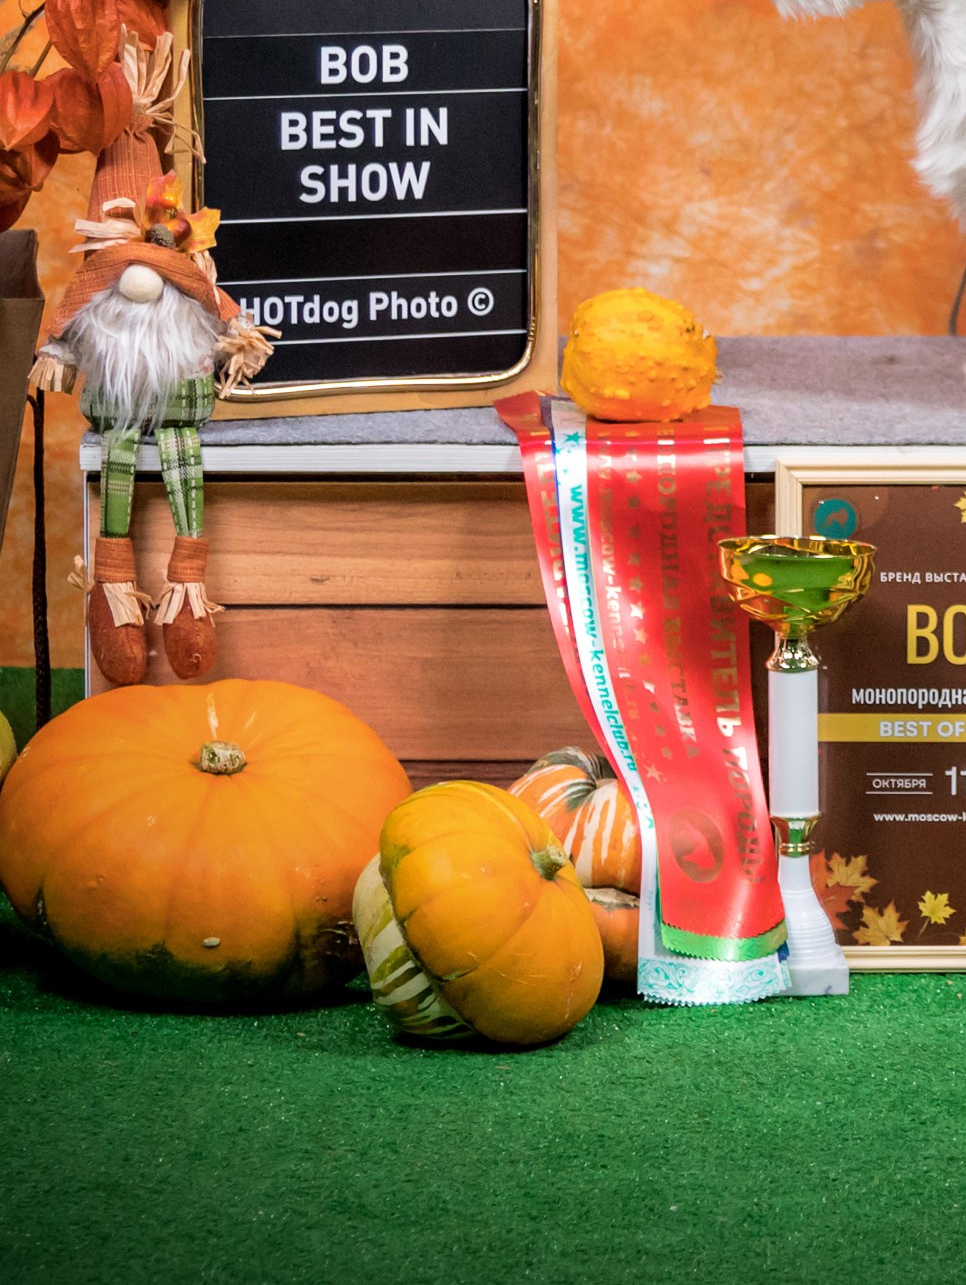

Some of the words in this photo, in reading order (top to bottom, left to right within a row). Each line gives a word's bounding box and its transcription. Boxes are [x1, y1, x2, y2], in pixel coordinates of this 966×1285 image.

[320, 44, 409, 85] BOB
[281, 108, 392, 151] BEST
[405, 106, 448, 147] IN
[299, 161, 431, 204] SHOW
[238, 294, 359, 331] HOTdog
[369, 291, 458, 321] Photo
[703, 437, 742, 737] ПРЕДСАВИТЕЛЬ
[879, 571, 922, 585] БРЕНД
[572, 484, 638, 772] www.moscow-kennelclub.ru
[879, 720, 932, 738] BEST
[936, 720, 966, 738] OF
[872, 778, 927, 789] ОКТЯБРЯ
